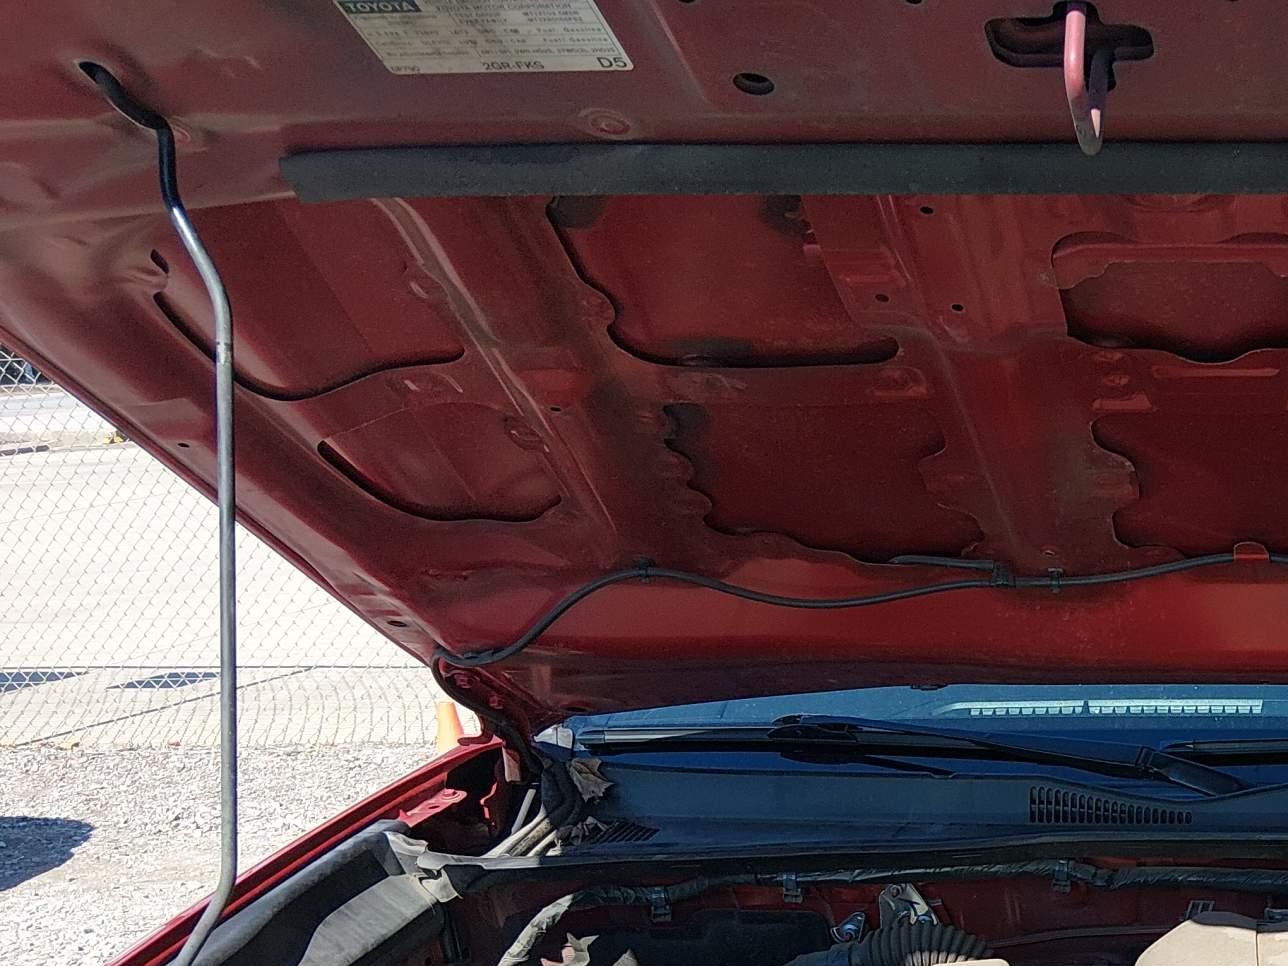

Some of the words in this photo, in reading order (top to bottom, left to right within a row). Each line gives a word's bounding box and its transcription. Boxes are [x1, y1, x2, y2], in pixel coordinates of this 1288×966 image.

[344, 0, 416, 13] TOYOTA
[482, 60, 544, 71] 2GR-FKS
[596, 56, 628, 69] D5
